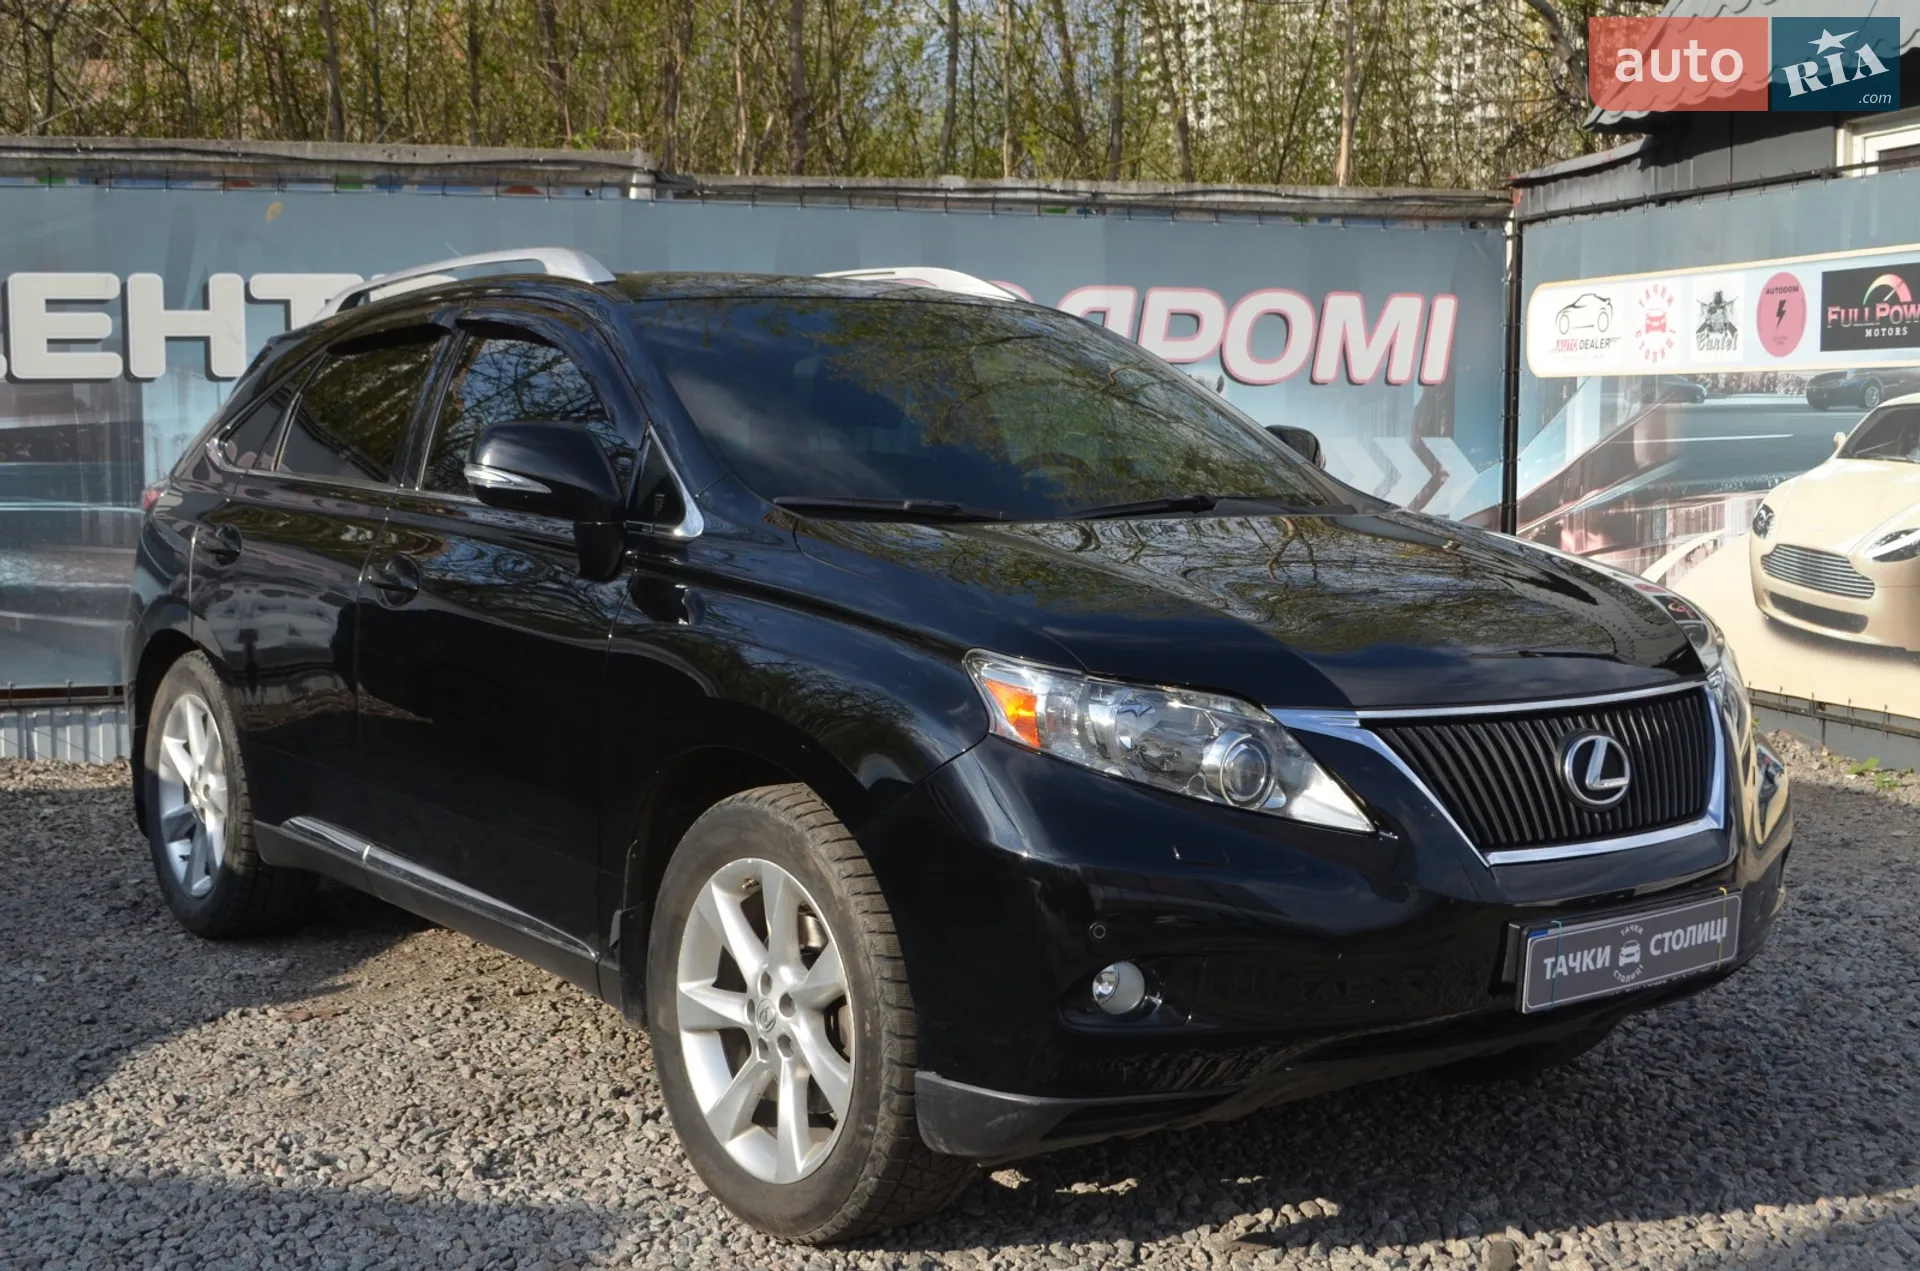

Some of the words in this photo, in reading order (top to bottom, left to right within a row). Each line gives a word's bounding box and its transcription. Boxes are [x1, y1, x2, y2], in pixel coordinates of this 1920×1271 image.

[1765, 285, 1799, 295] AUTODOM
[0, 272, 457, 382] ЕНТ
[1865, 326, 1908, 338] MOTORS
[1579, 338, 1612, 351] DEALER
[1543, 945, 1611, 980] ТАЧКИ
[1650, 917, 1728, 956] СТОЛИЦІ
